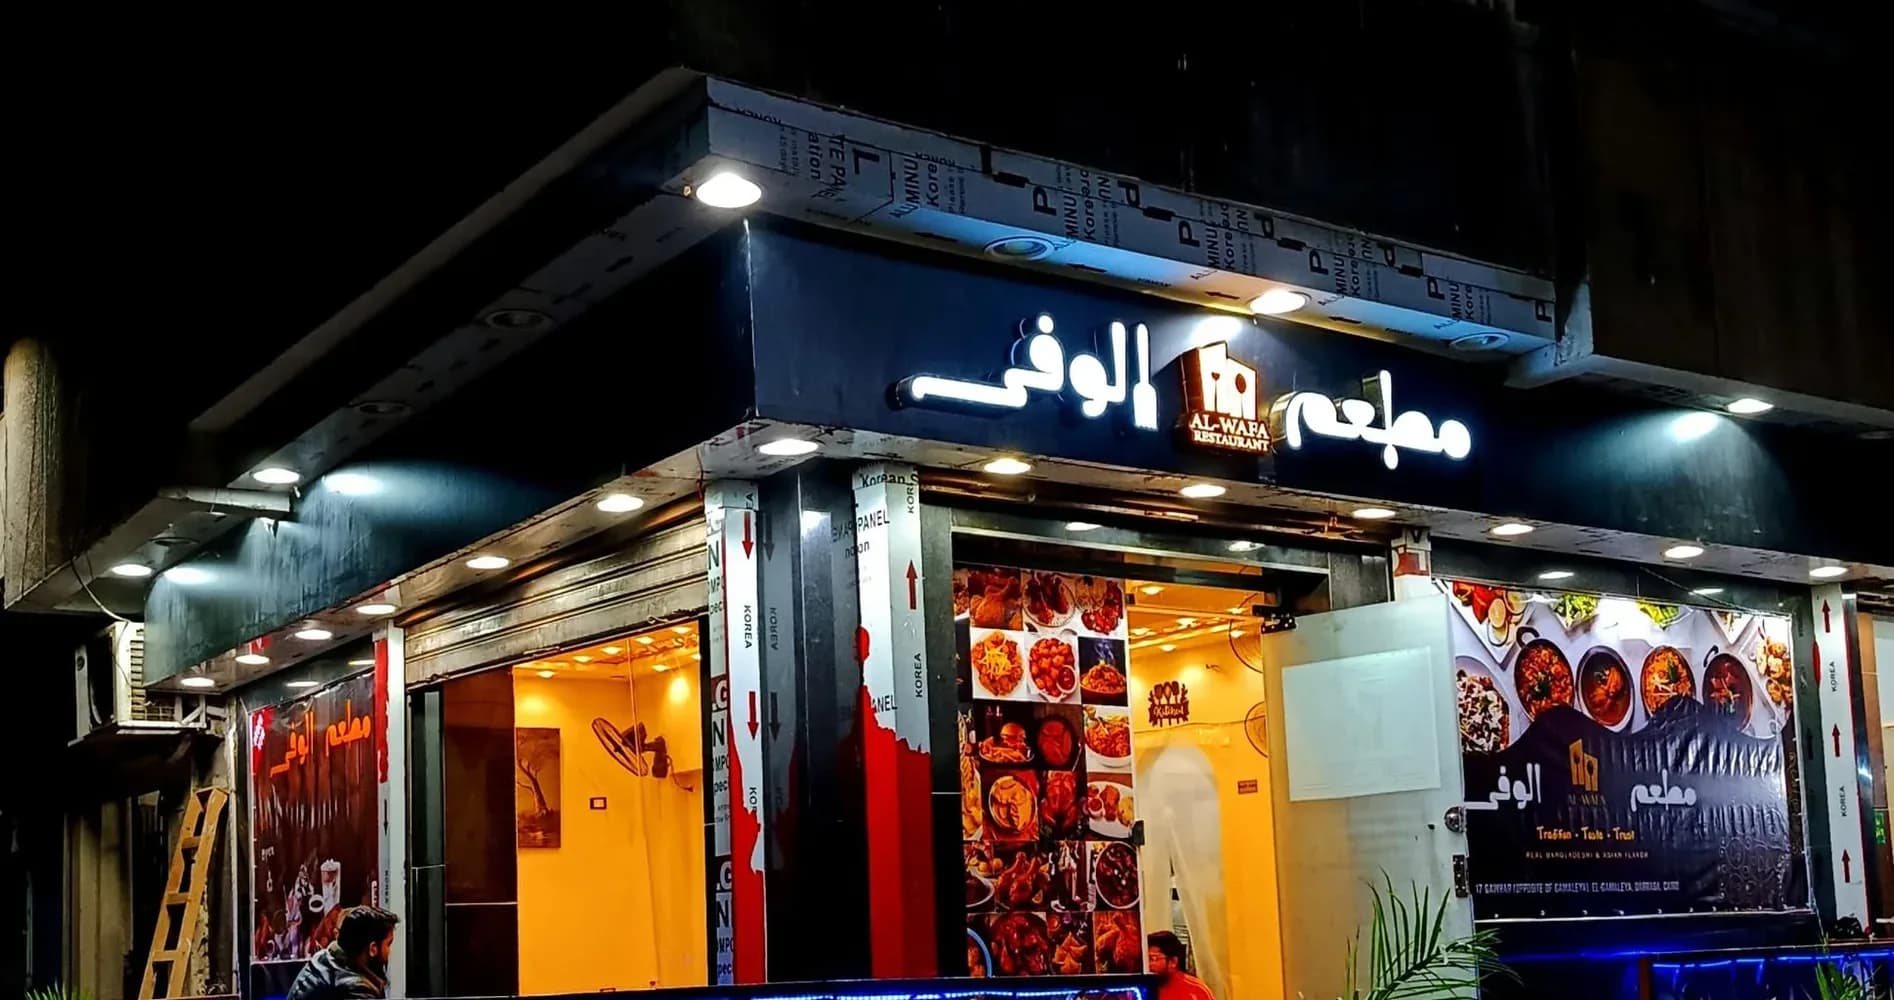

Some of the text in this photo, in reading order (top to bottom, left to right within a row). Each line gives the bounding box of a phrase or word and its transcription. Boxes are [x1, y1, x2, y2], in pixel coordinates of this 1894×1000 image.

[1189, 413, 1270, 439] AL-WAFA
[1193, 430, 1270, 452] RESTAURANT
[1288, 369, 1472, 470] مطعم
[743, 605, 753, 649] KOREA
[914, 652, 924, 698] KOREA
[1828, 661, 1837, 692] KOREA
[325, 699, 372, 757] مطعم
[1629, 768, 1697, 813] مطعم
